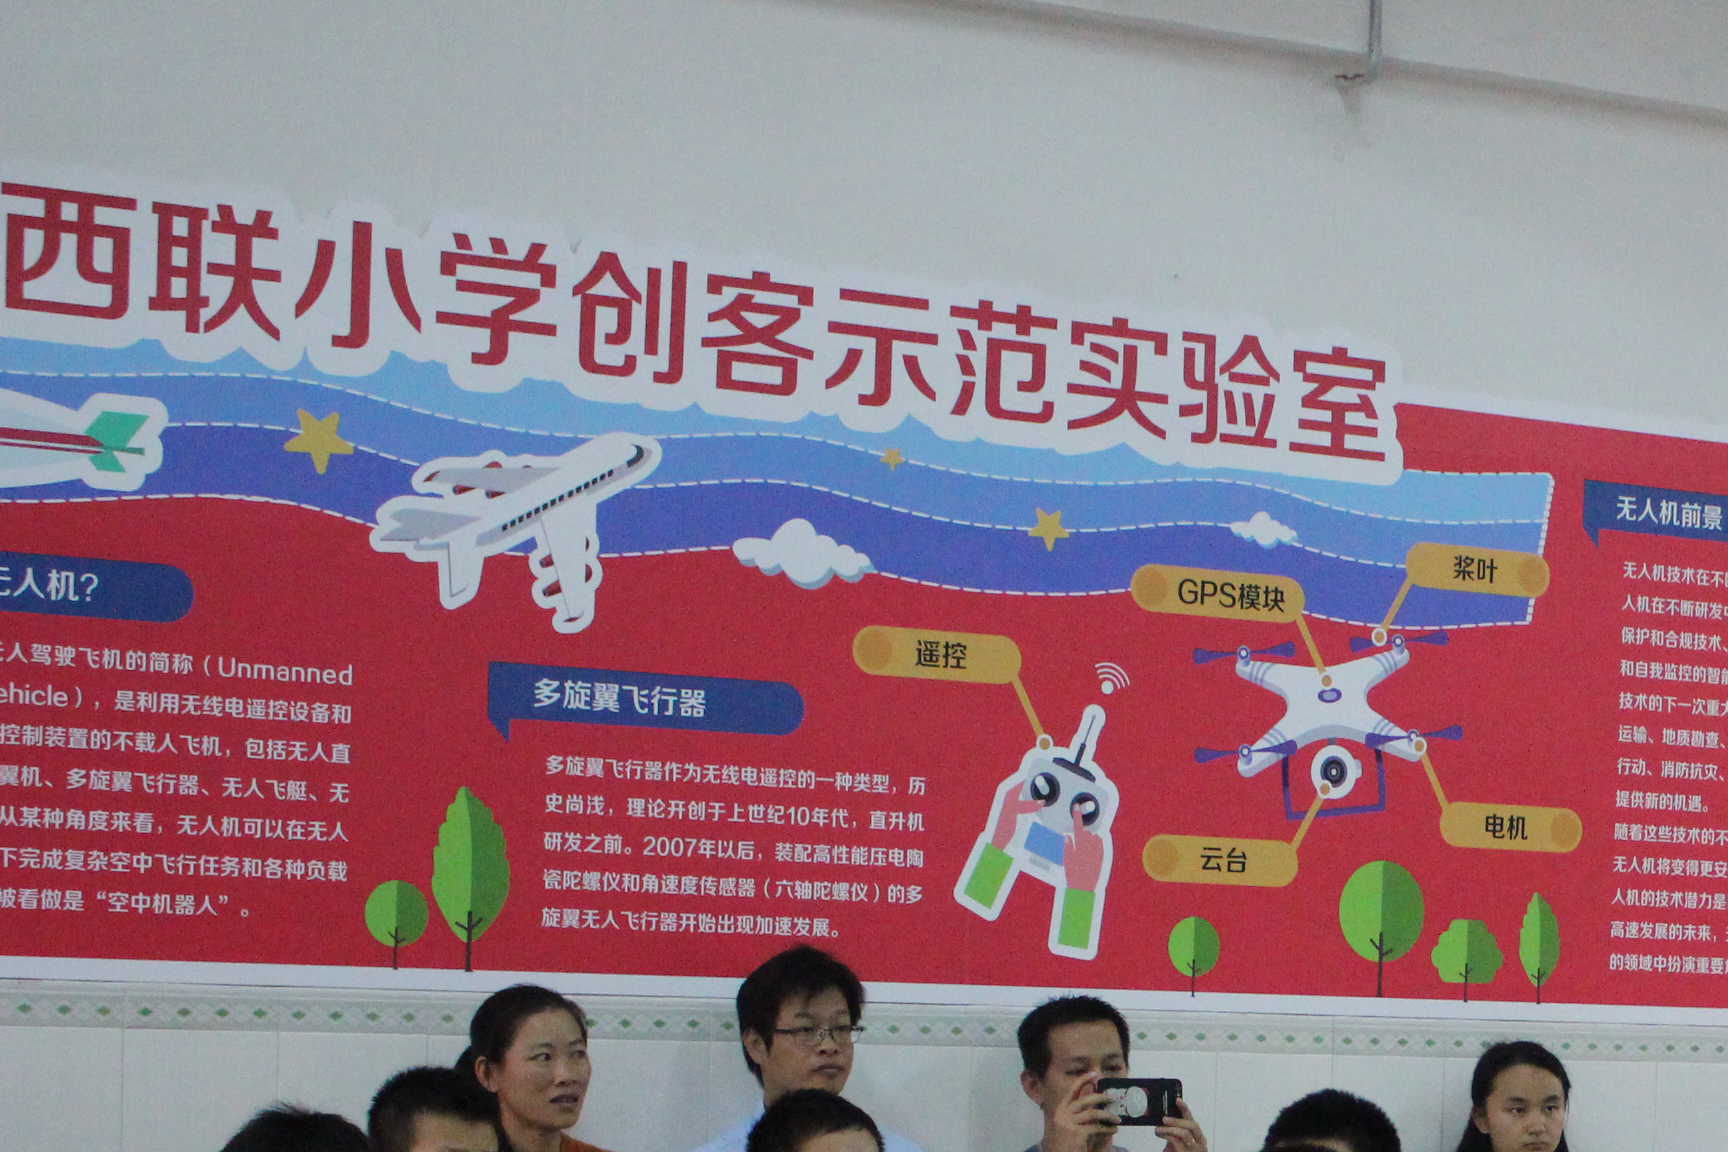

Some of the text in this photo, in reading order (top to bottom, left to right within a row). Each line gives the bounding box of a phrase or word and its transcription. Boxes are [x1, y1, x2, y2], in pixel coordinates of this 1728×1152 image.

[4, 184, 1385, 461] 西联小学创客示范实验室
[1617, 496, 1722, 531] 无人机前景
[1454, 555, 1497, 583] 桨叶
[1178, 579, 1284, 612] GPS模块
[916, 640, 967, 669] 遥控
[534, 678, 705, 717] 多旋翼飞行器
[1485, 814, 1527, 840] 电机
[1201, 847, 1246, 872] 云台
